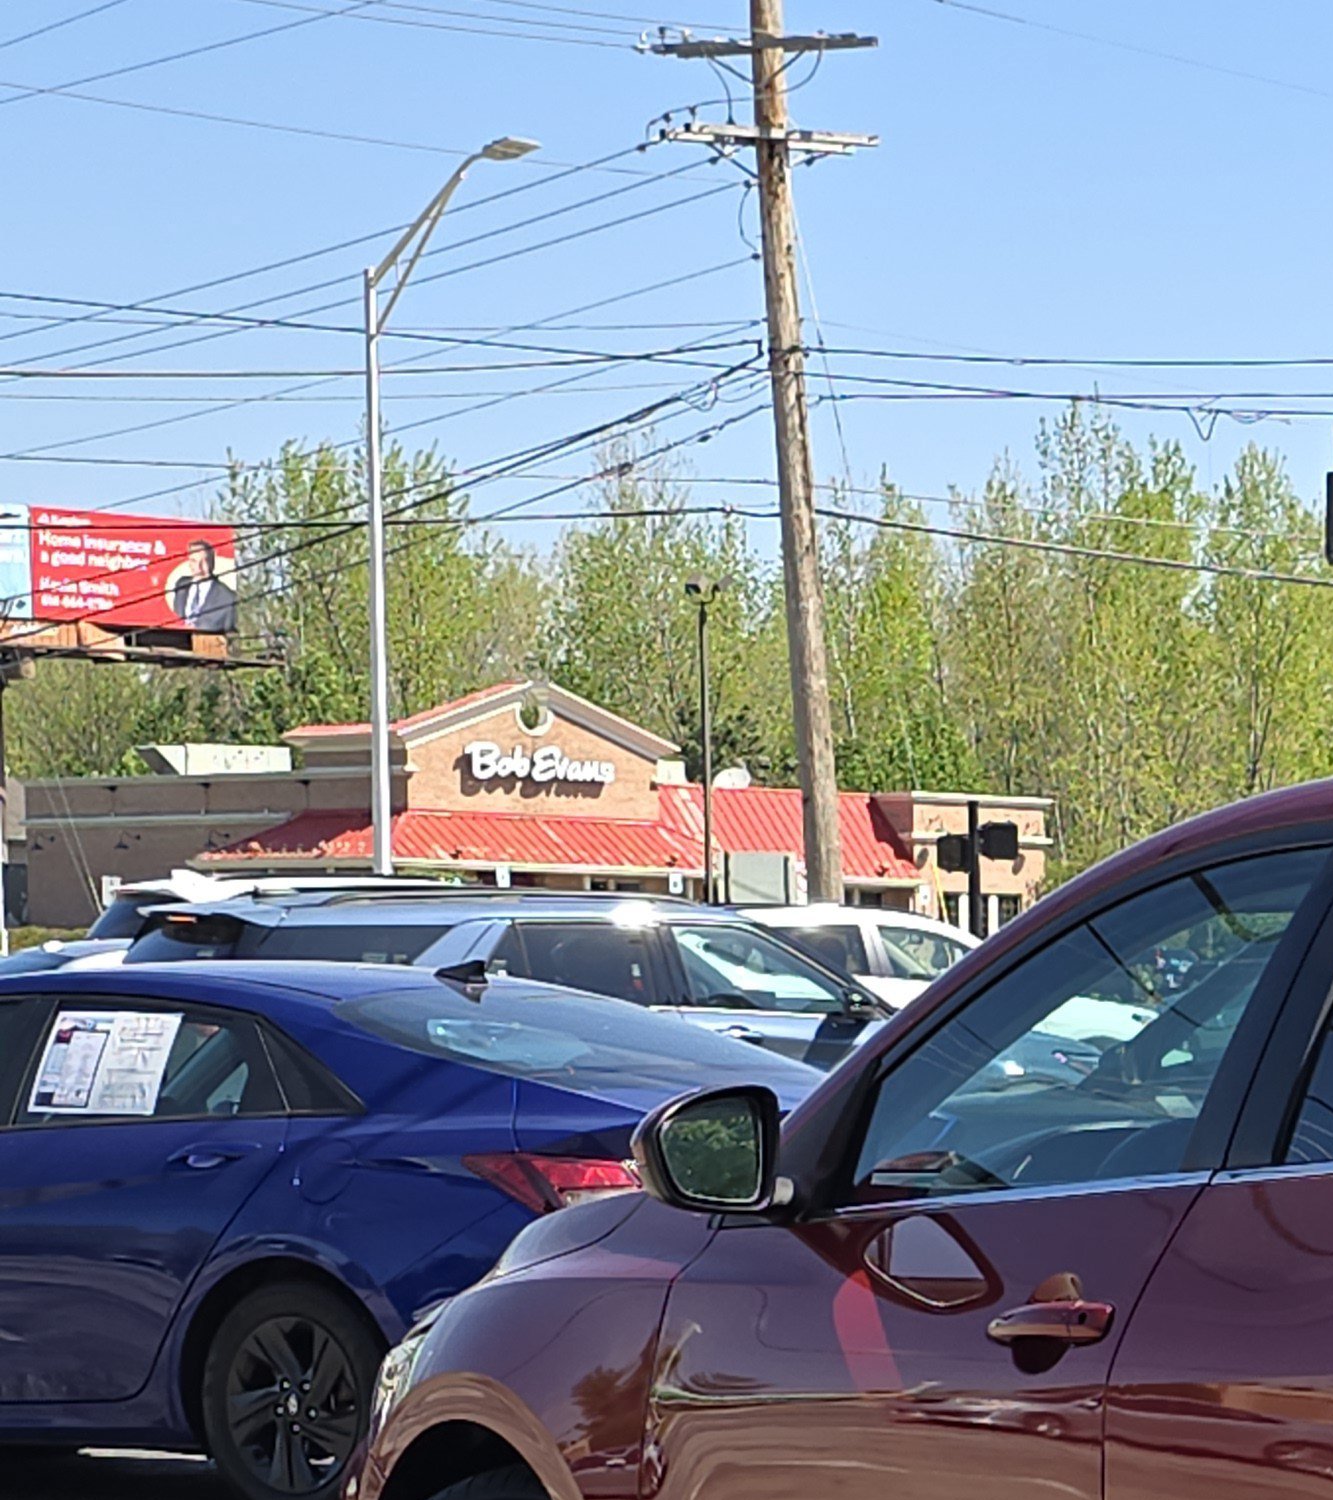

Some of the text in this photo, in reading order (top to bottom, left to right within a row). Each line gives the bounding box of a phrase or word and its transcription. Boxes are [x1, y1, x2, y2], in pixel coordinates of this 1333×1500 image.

[38, 531, 82, 549] Home
[50, 551, 87, 569] good
[464, 740, 616, 784] Bob Evans
